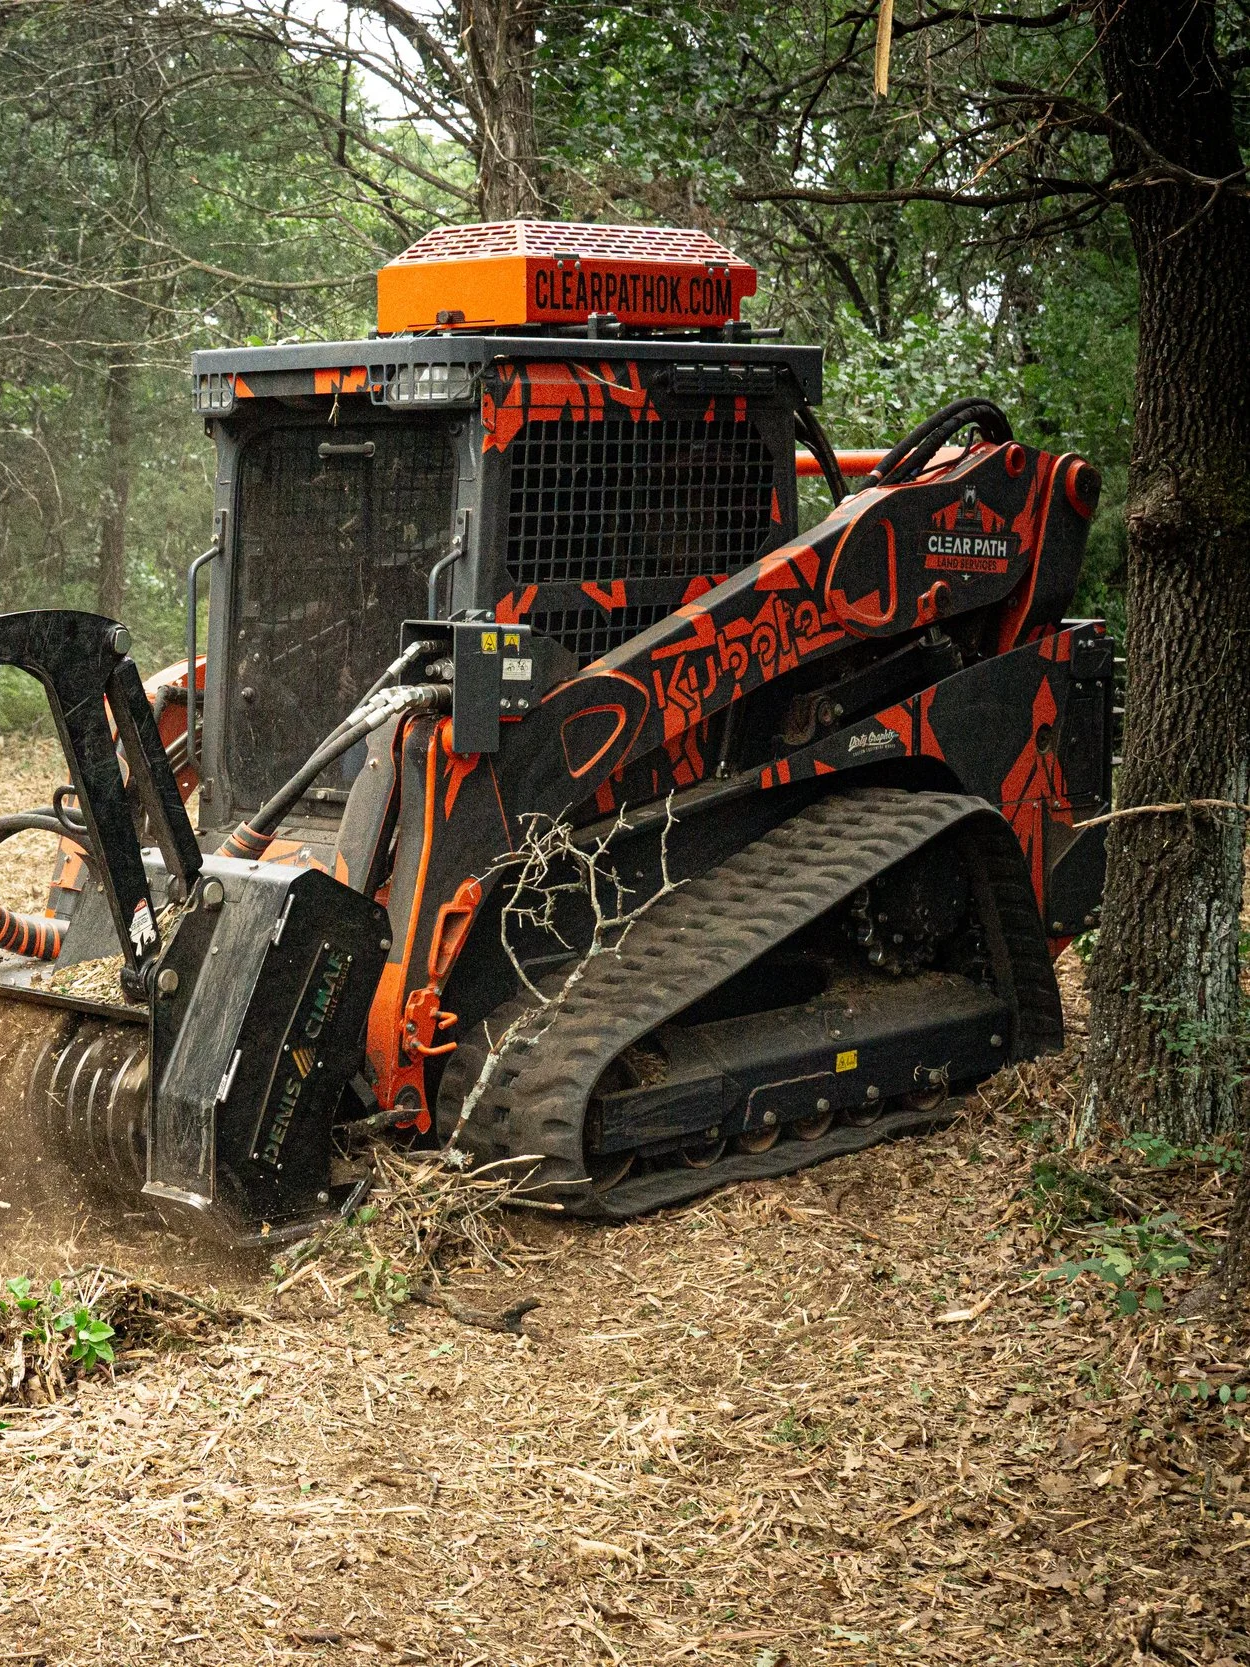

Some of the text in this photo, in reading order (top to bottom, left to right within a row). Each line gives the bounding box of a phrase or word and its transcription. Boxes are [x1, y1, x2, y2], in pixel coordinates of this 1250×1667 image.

[534, 269, 733, 317] CLEARPATHOK.COM
[927, 535, 1007, 557] CLEAR PATH
[937, 556, 997, 572] LAND SERVICES
[263, 1076, 302, 1165] DENIS
